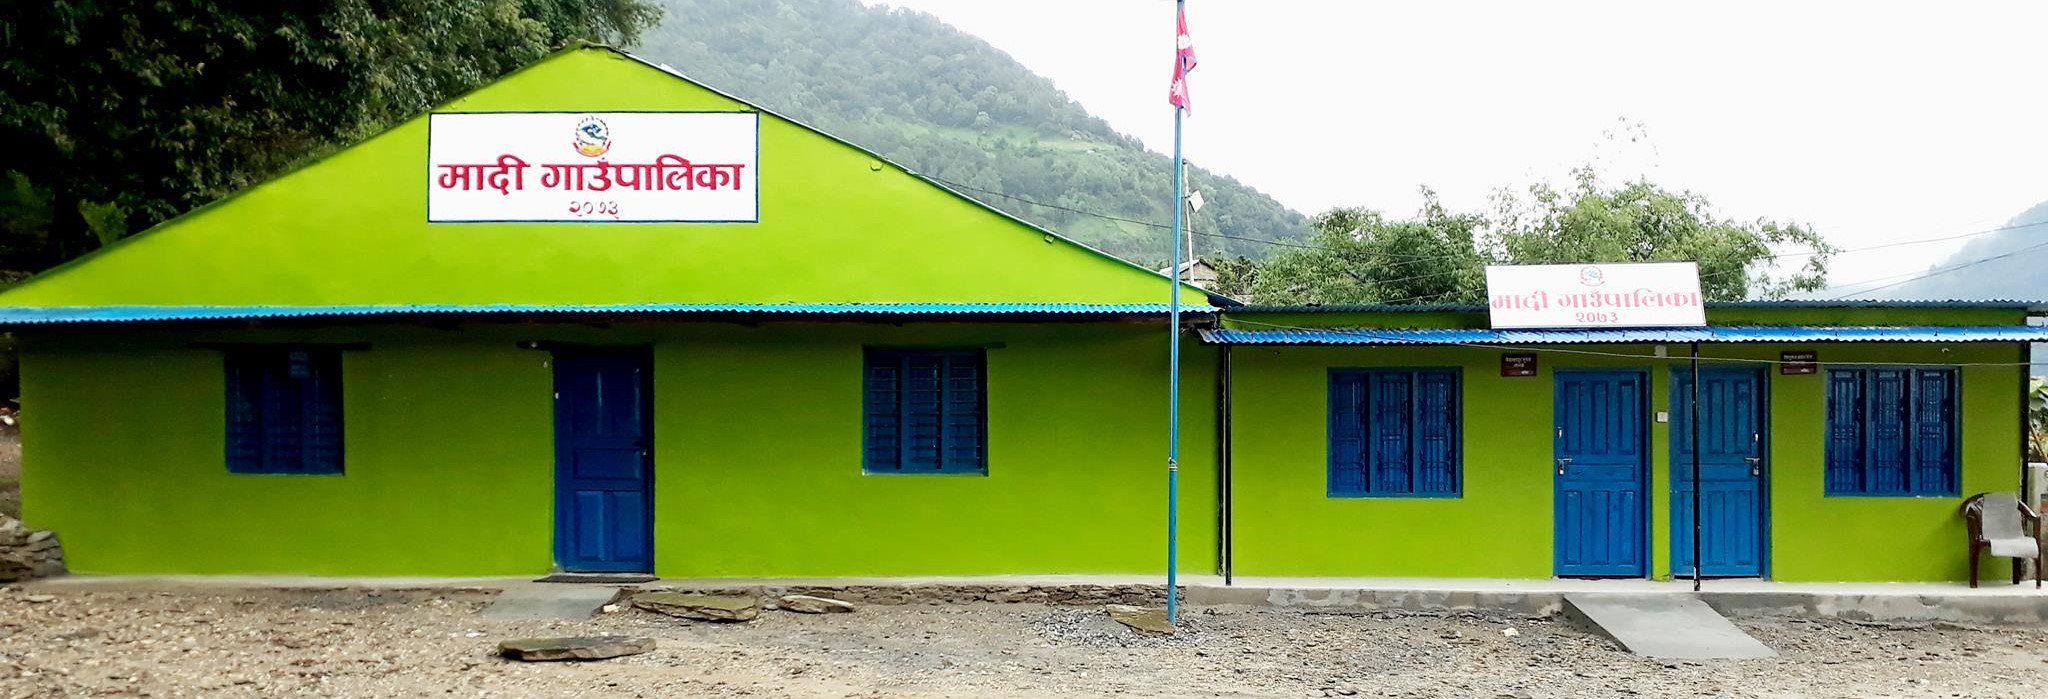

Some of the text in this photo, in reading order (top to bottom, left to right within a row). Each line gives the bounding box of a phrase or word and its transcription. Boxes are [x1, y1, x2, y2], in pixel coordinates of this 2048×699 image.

[437, 153, 745, 195] मादी गाउँपालिका
[568, 200, 619, 219] २०७३
[1491, 288, 1699, 311] मादी गाउँपालिका
[1575, 311, 1619, 323] २०७३
